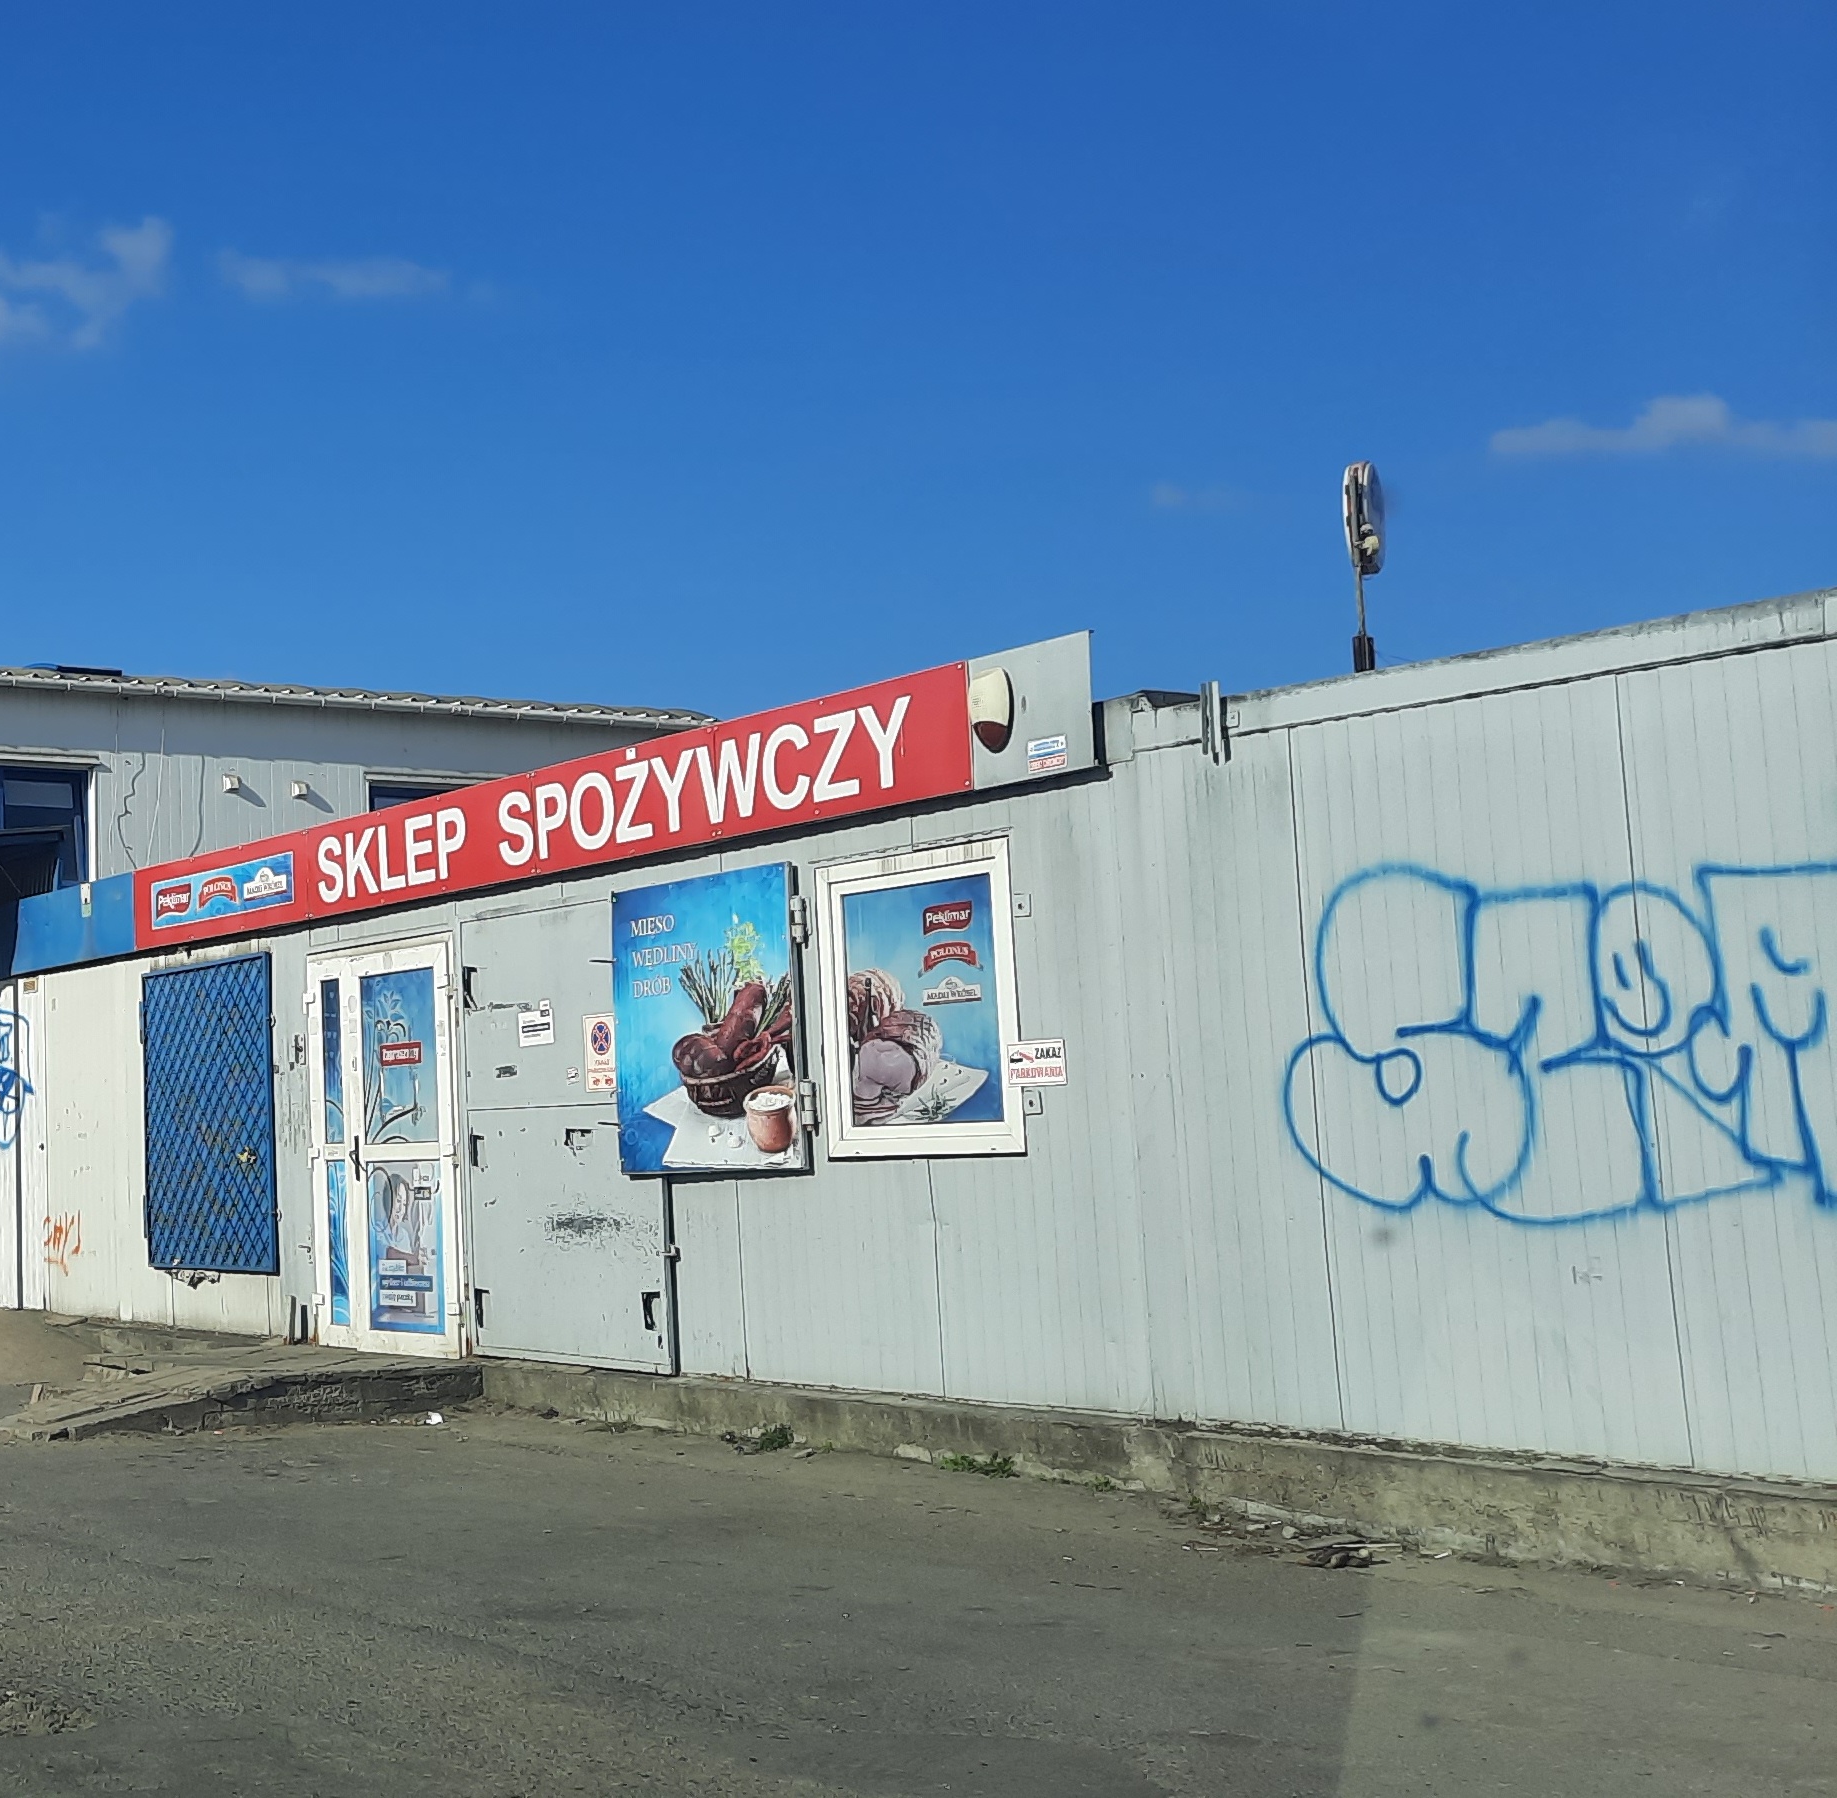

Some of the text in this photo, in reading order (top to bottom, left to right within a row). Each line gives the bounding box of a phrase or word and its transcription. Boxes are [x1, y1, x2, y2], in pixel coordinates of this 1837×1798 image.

[317, 696, 912, 904] SKLEP SPOŻYWCZY
[630, 914, 675, 939] MIĘSO
[632, 942, 698, 971] WĘDLINY
[930, 946, 970, 959] POLONUS
[632, 975, 672, 998] DRÓB
[1034, 1046, 1062, 1060] ZAKAZ
[1010, 1066, 1063, 1080] PARKOWANIA
